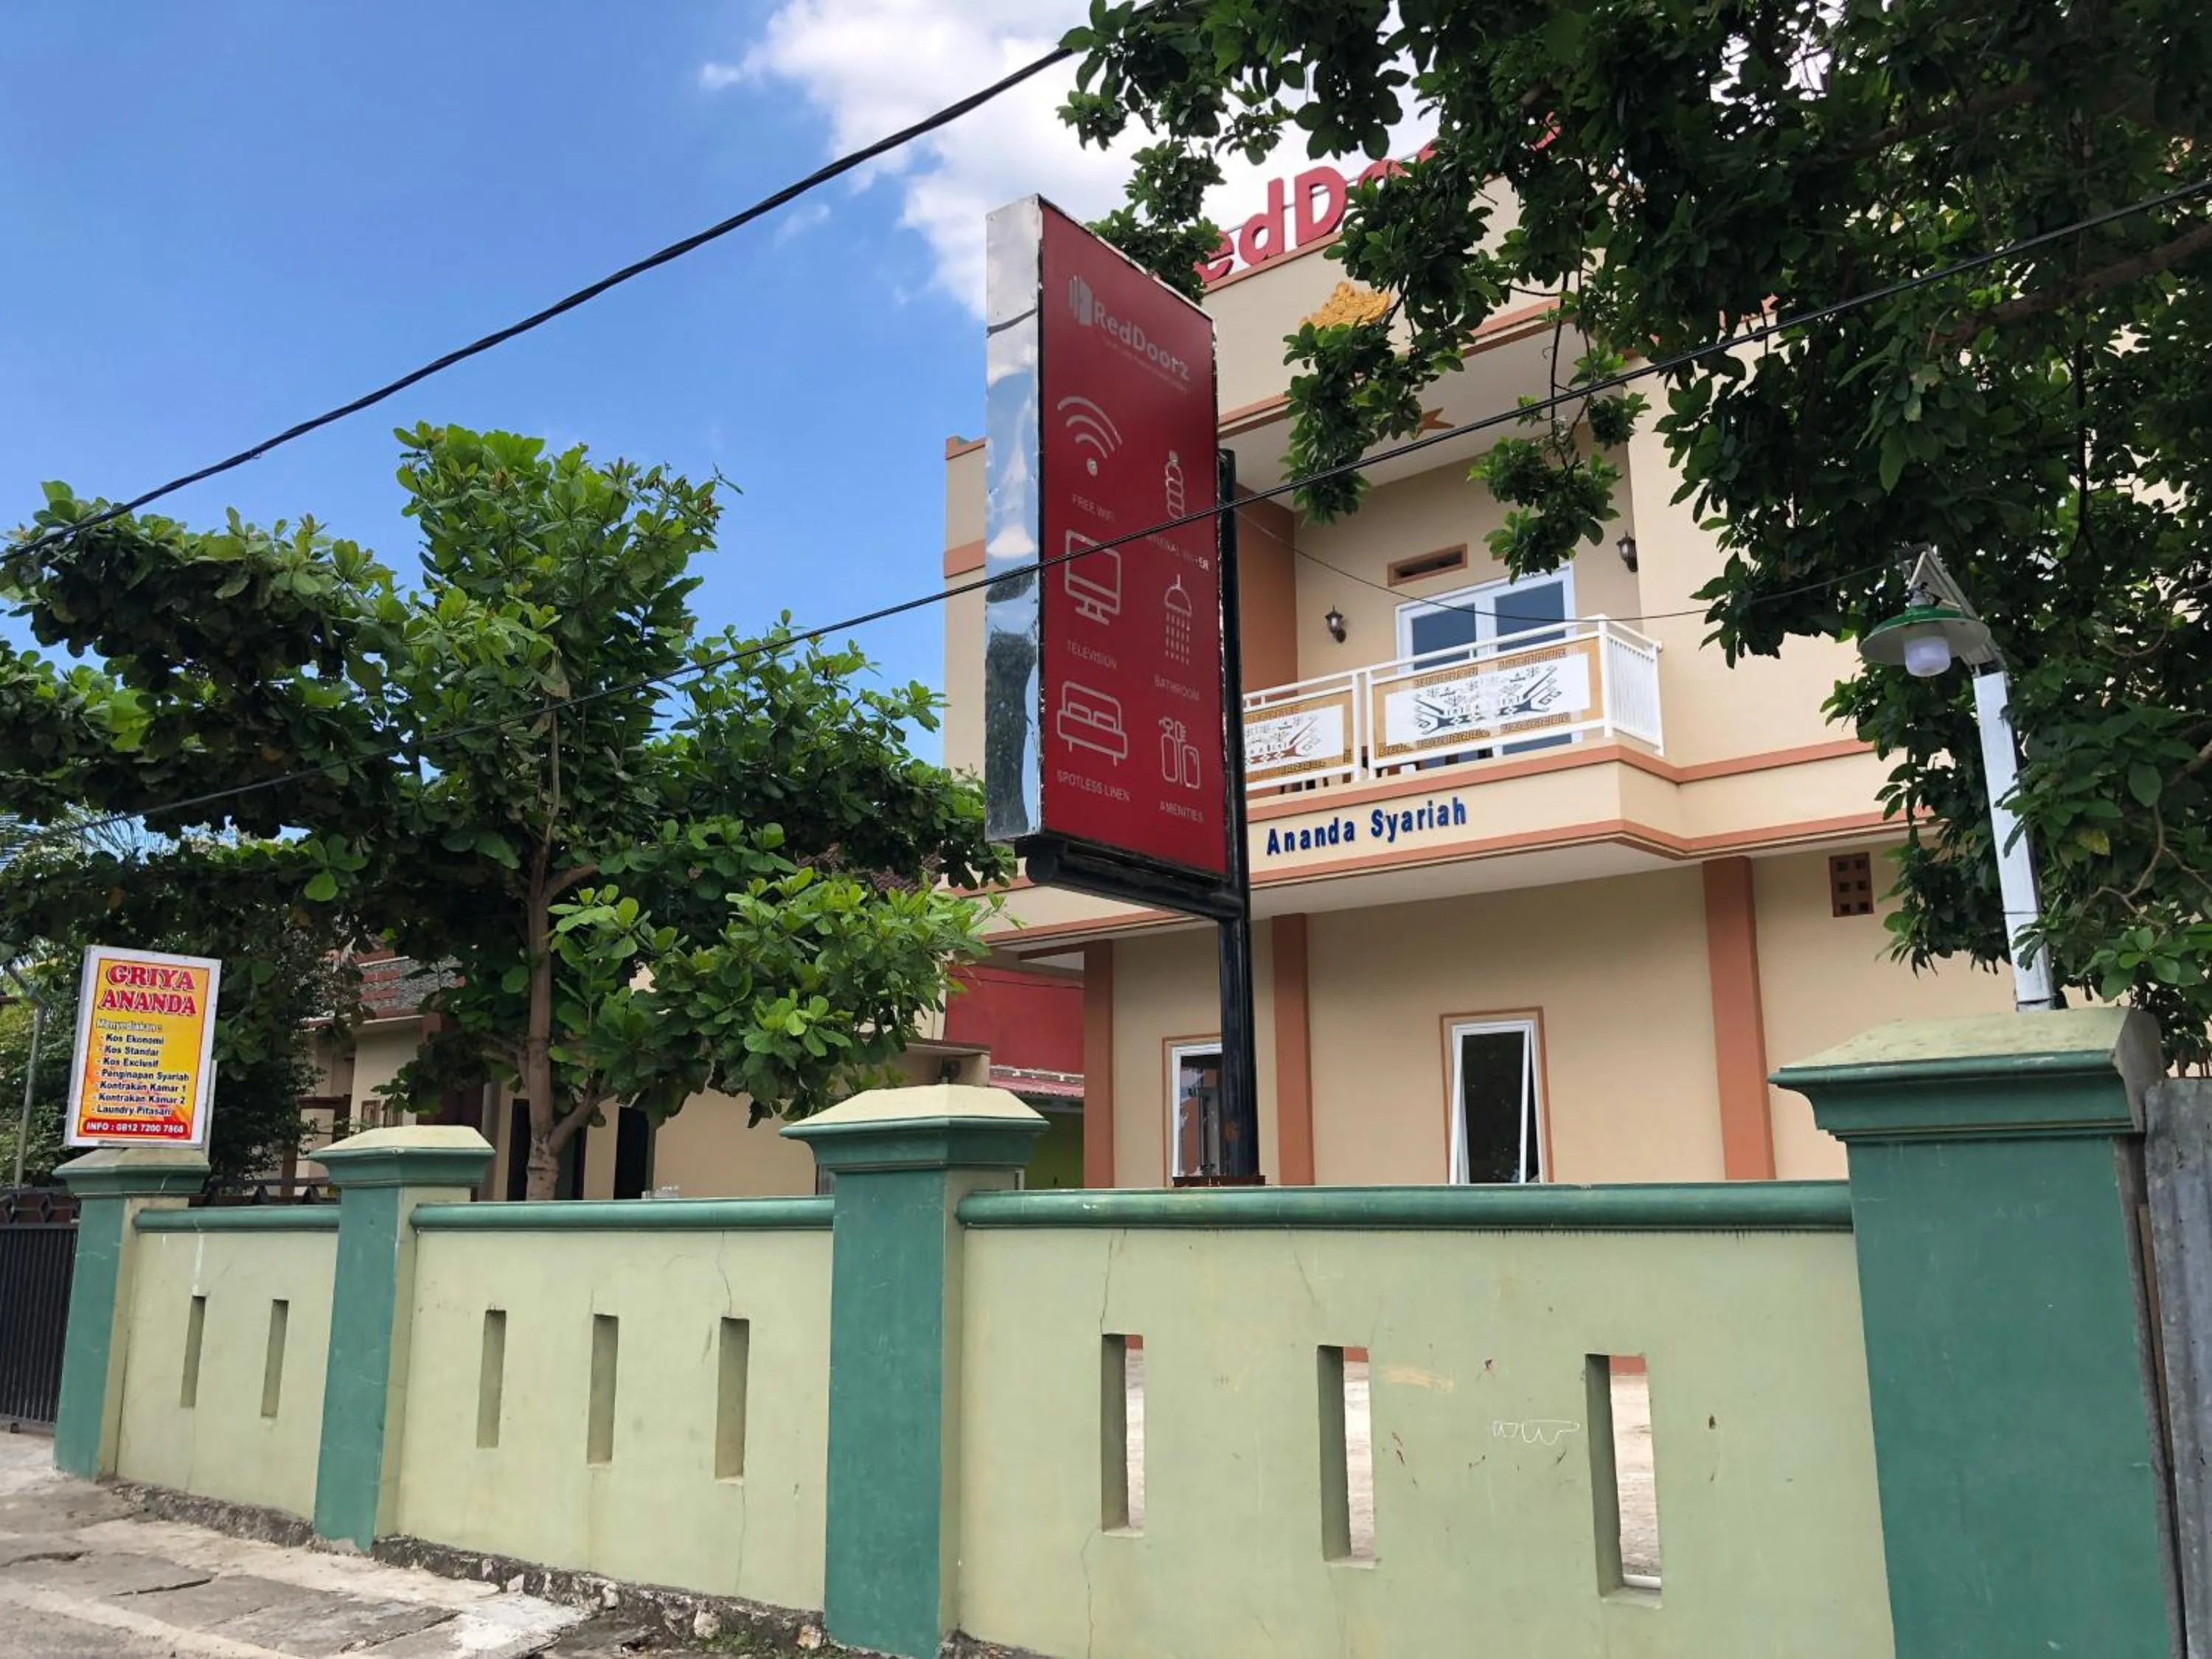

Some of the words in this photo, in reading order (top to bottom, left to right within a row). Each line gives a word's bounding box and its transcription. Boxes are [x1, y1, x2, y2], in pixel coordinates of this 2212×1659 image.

[1095, 302, 1190, 380] RedDoorz
[1071, 493, 1095, 514] FREE
[1066, 639, 1118, 670] TELEVISION
[1154, 674, 1200, 701] BATHROOM
[1057, 769, 1102, 794] SPOTLESS
[1160, 801, 1203, 824] AMENITIES
[1266, 817, 1355, 856] Ananda
[1371, 797, 1467, 843] Syariah
[105, 964, 195, 992] GRIYA
[98, 990, 197, 1015] ANANDA
[105, 1034, 123, 1043] Kos
[126, 1034, 164, 1045] Ekonomi
[104, 1045, 122, 1054] Kos
[125, 1046, 159, 1056] Standar
[102, 1057, 119, 1065] Kos
[123, 1057, 159, 1067] Exclusif
[101, 1069, 154, 1079] Penginapan
[156, 1071, 189, 1081] Syariah
[100, 1081, 147, 1091] Kontrakan
[150, 1083, 178, 1092] Kamar
[148, 1095, 177, 1104] Kamar
[97, 1105, 134, 1116] Laundry
[86, 1121, 109, 1131] INFO
